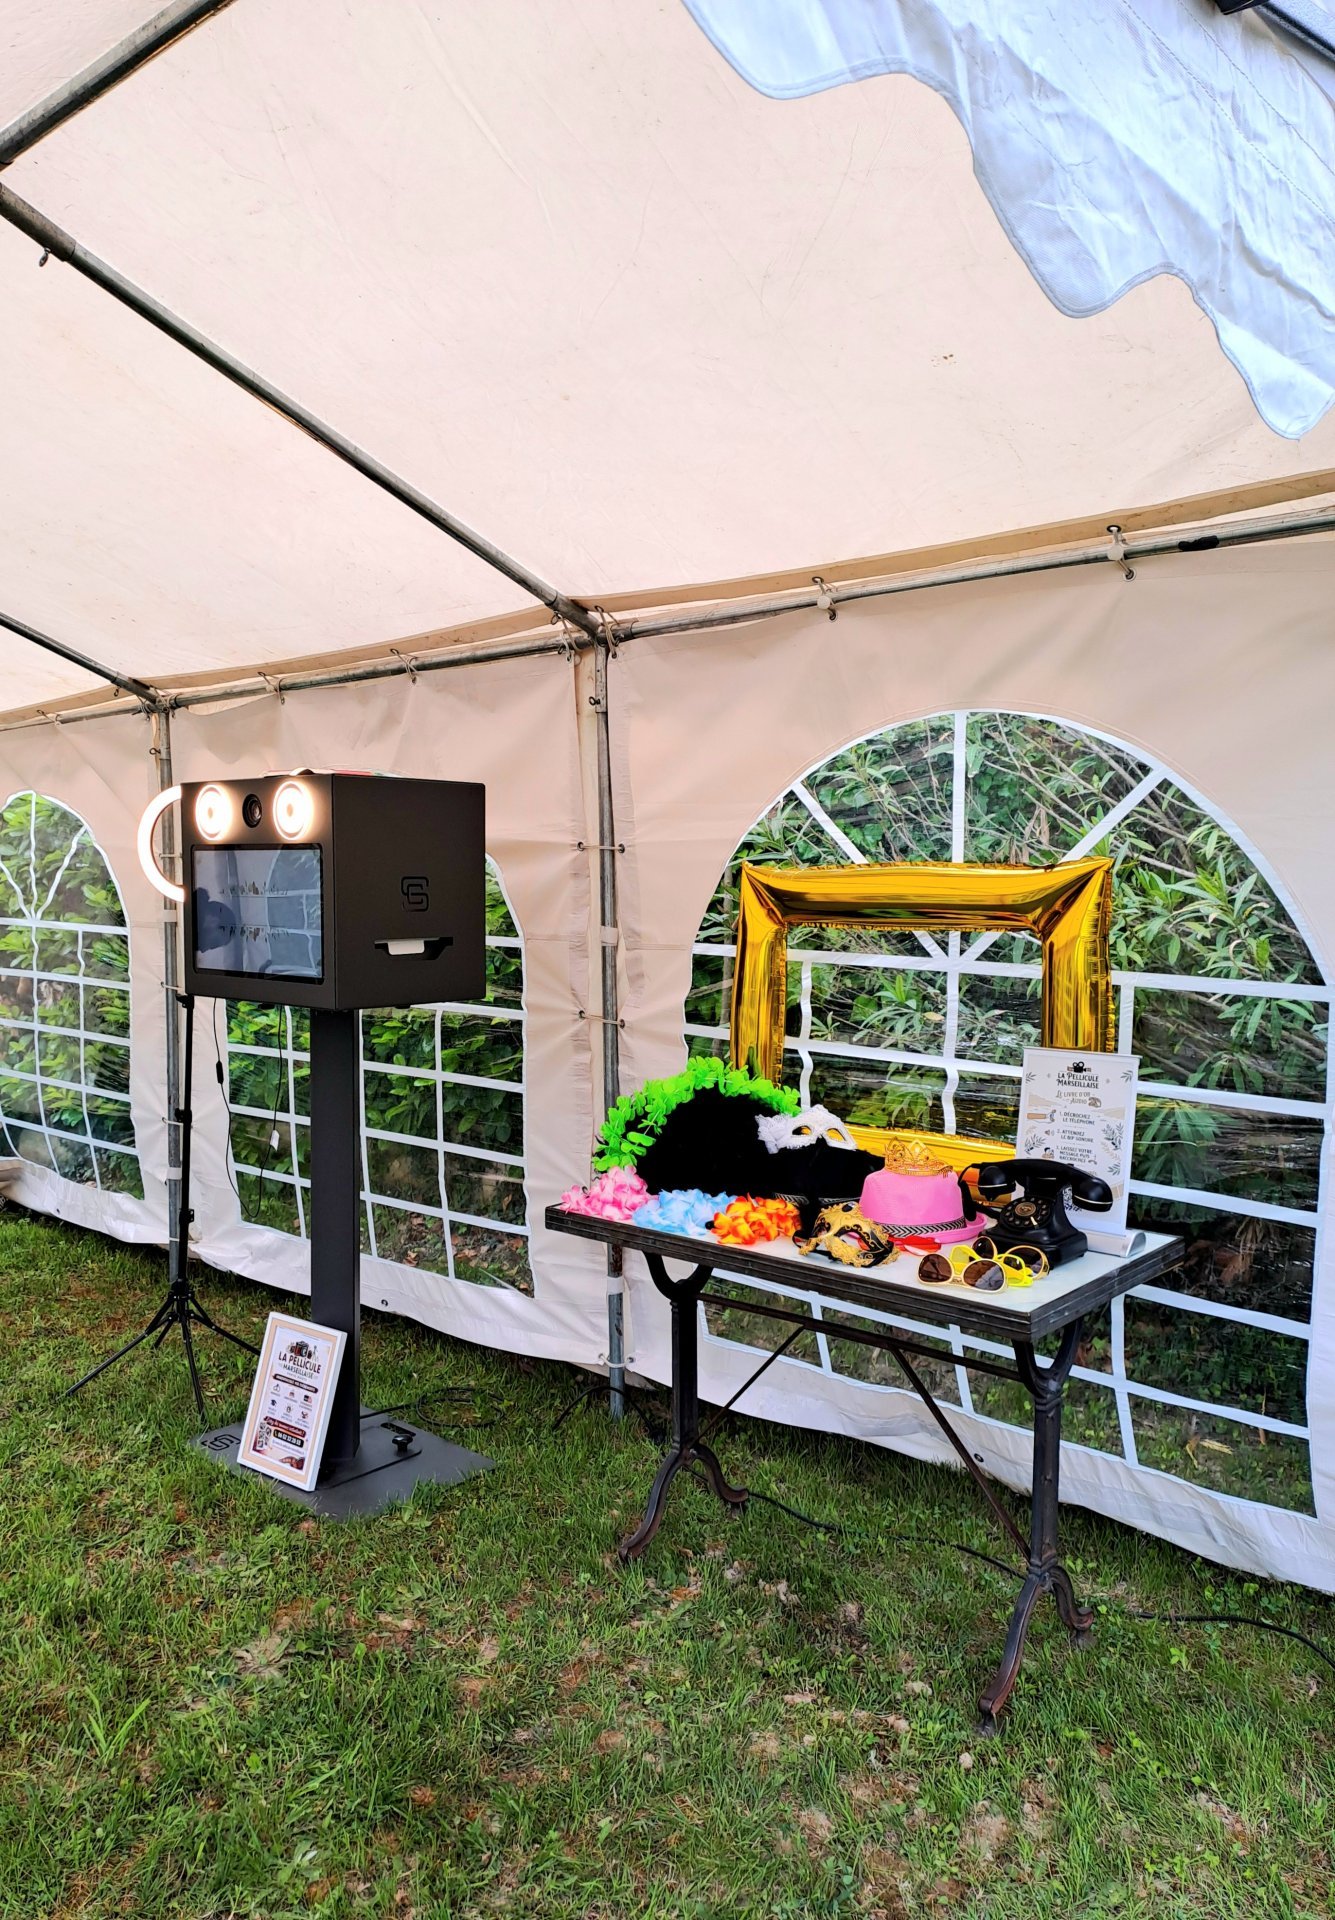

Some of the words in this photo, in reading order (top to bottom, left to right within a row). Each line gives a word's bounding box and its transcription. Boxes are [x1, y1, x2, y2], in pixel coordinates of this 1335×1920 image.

[1066, 1072, 1099, 1082] PELLICULE
[1056, 1079, 1099, 1089] MARSEILLAISE
[278, 1351, 287, 1362] LA
[289, 1355, 321, 1374] PELLICULE
[282, 1363, 314, 1379] MARSEILLAISE
